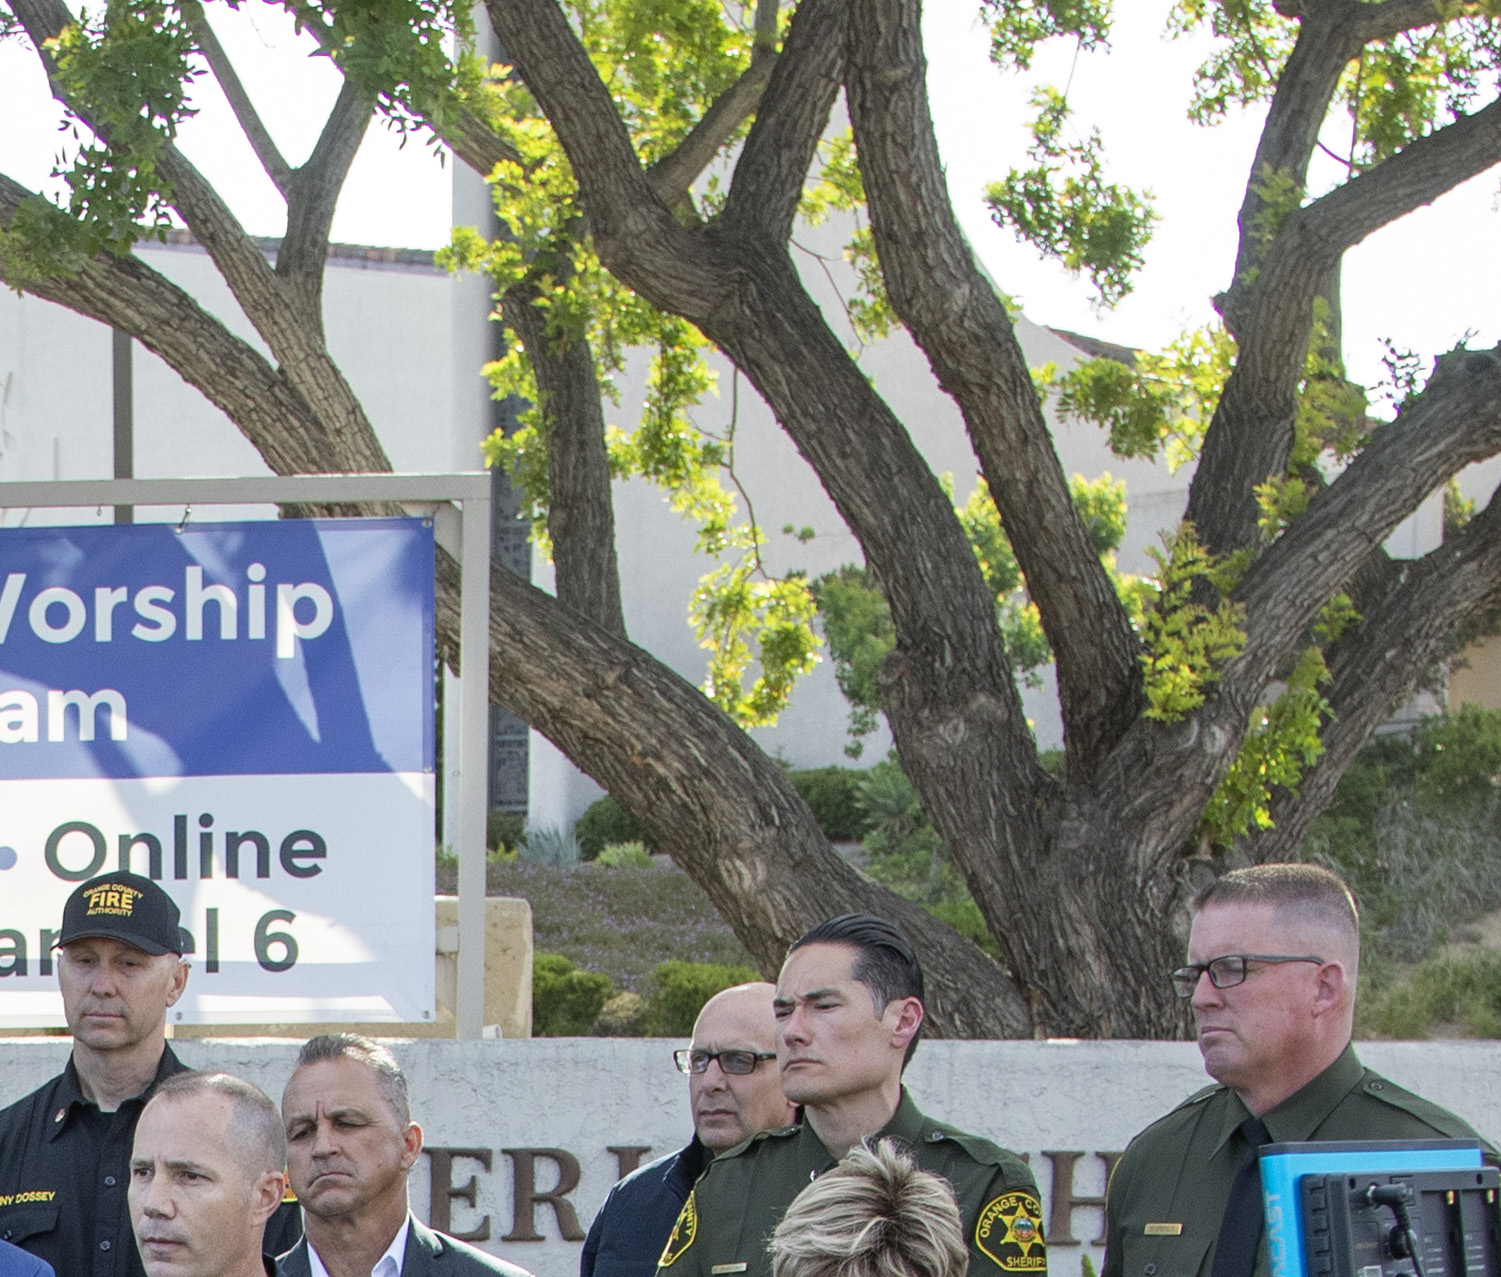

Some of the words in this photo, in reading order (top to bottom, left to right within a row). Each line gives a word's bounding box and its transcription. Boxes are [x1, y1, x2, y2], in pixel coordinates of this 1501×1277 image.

[44, 813, 327, 882] Online
[83, 884, 111, 897] ORANGE
[112, 884, 144, 899] COUNTY
[89, 891, 134, 909] FIRE
[87, 907, 133, 917] AUTHORITY
[255, 911, 297, 972] 6
[15, 1191, 56, 1205] DOSSEY
[979, 1197, 1018, 1239] ORANGE
[1006, 1256, 1046, 1268] SHERIF
